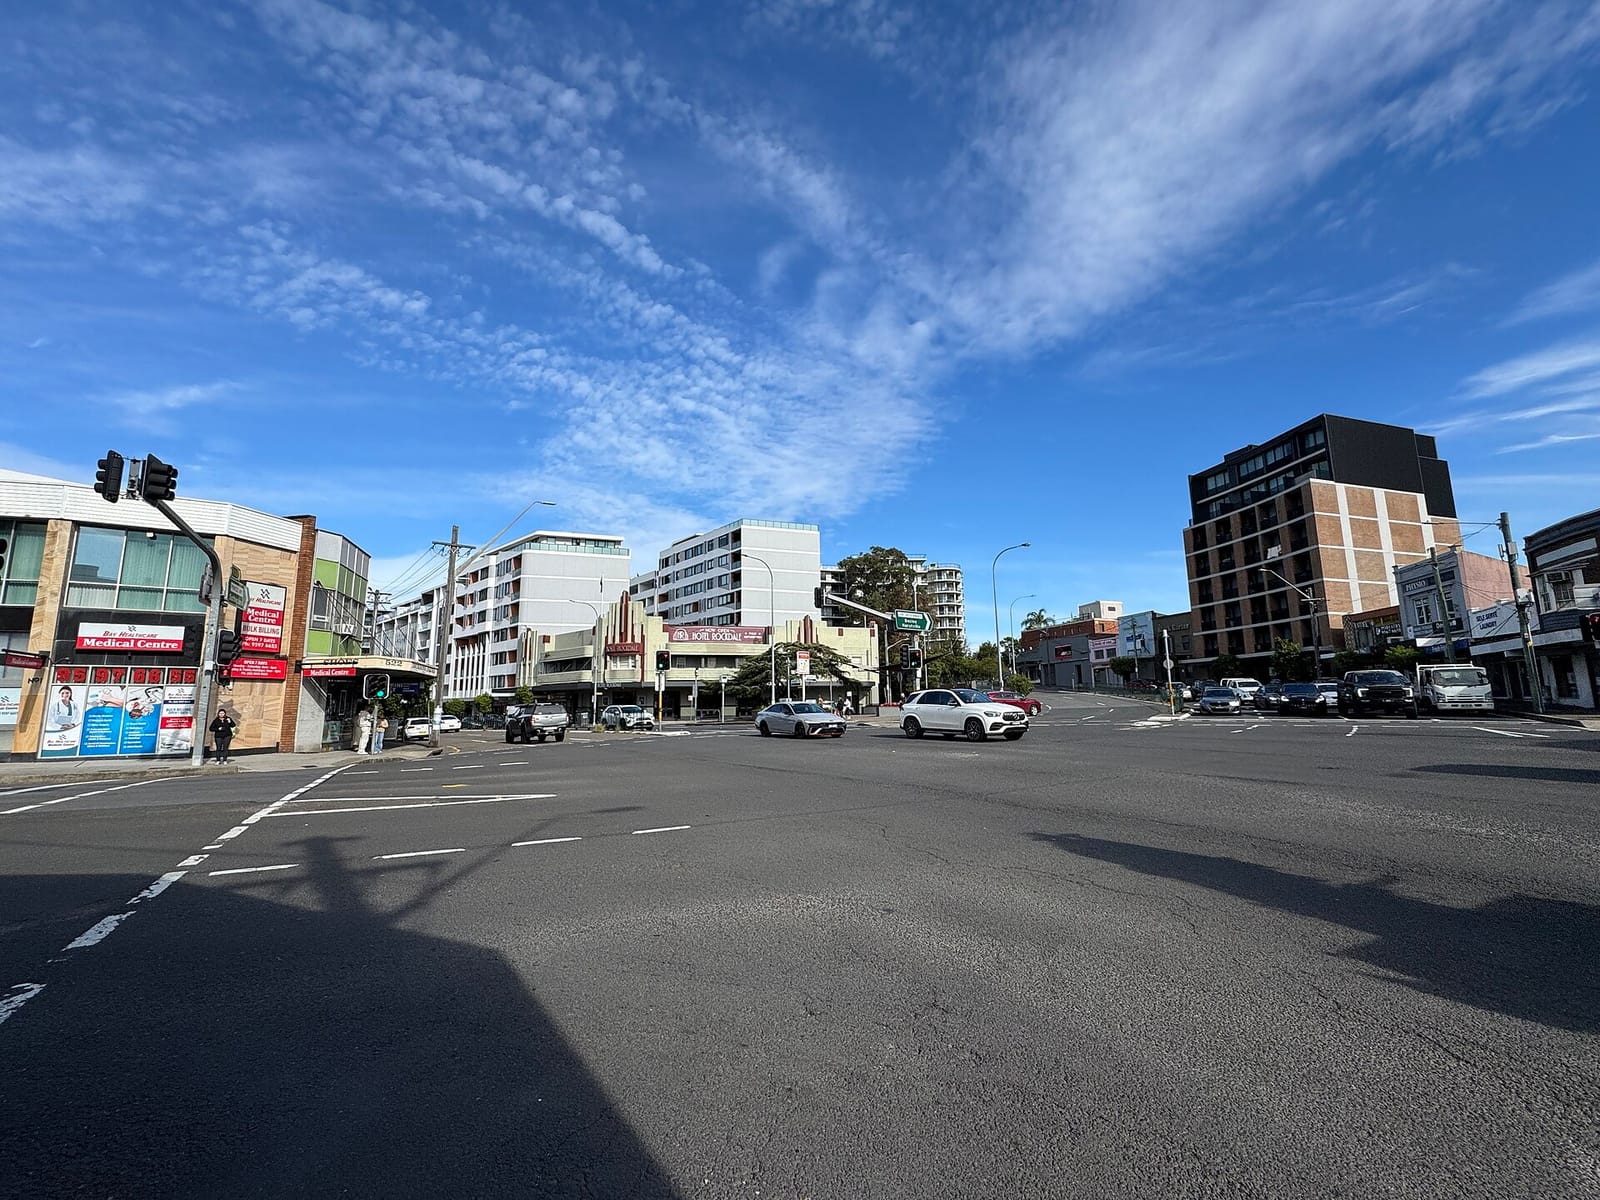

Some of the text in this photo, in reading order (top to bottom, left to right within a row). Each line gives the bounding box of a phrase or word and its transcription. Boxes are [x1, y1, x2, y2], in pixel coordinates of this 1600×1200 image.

[247, 608, 280, 618] Medical
[248, 614, 277, 624] Centre
[691, 633, 710, 641] HOTEL
[711, 633, 742, 641] ROCKDALE
[83, 638, 178, 649] Medical Centre
